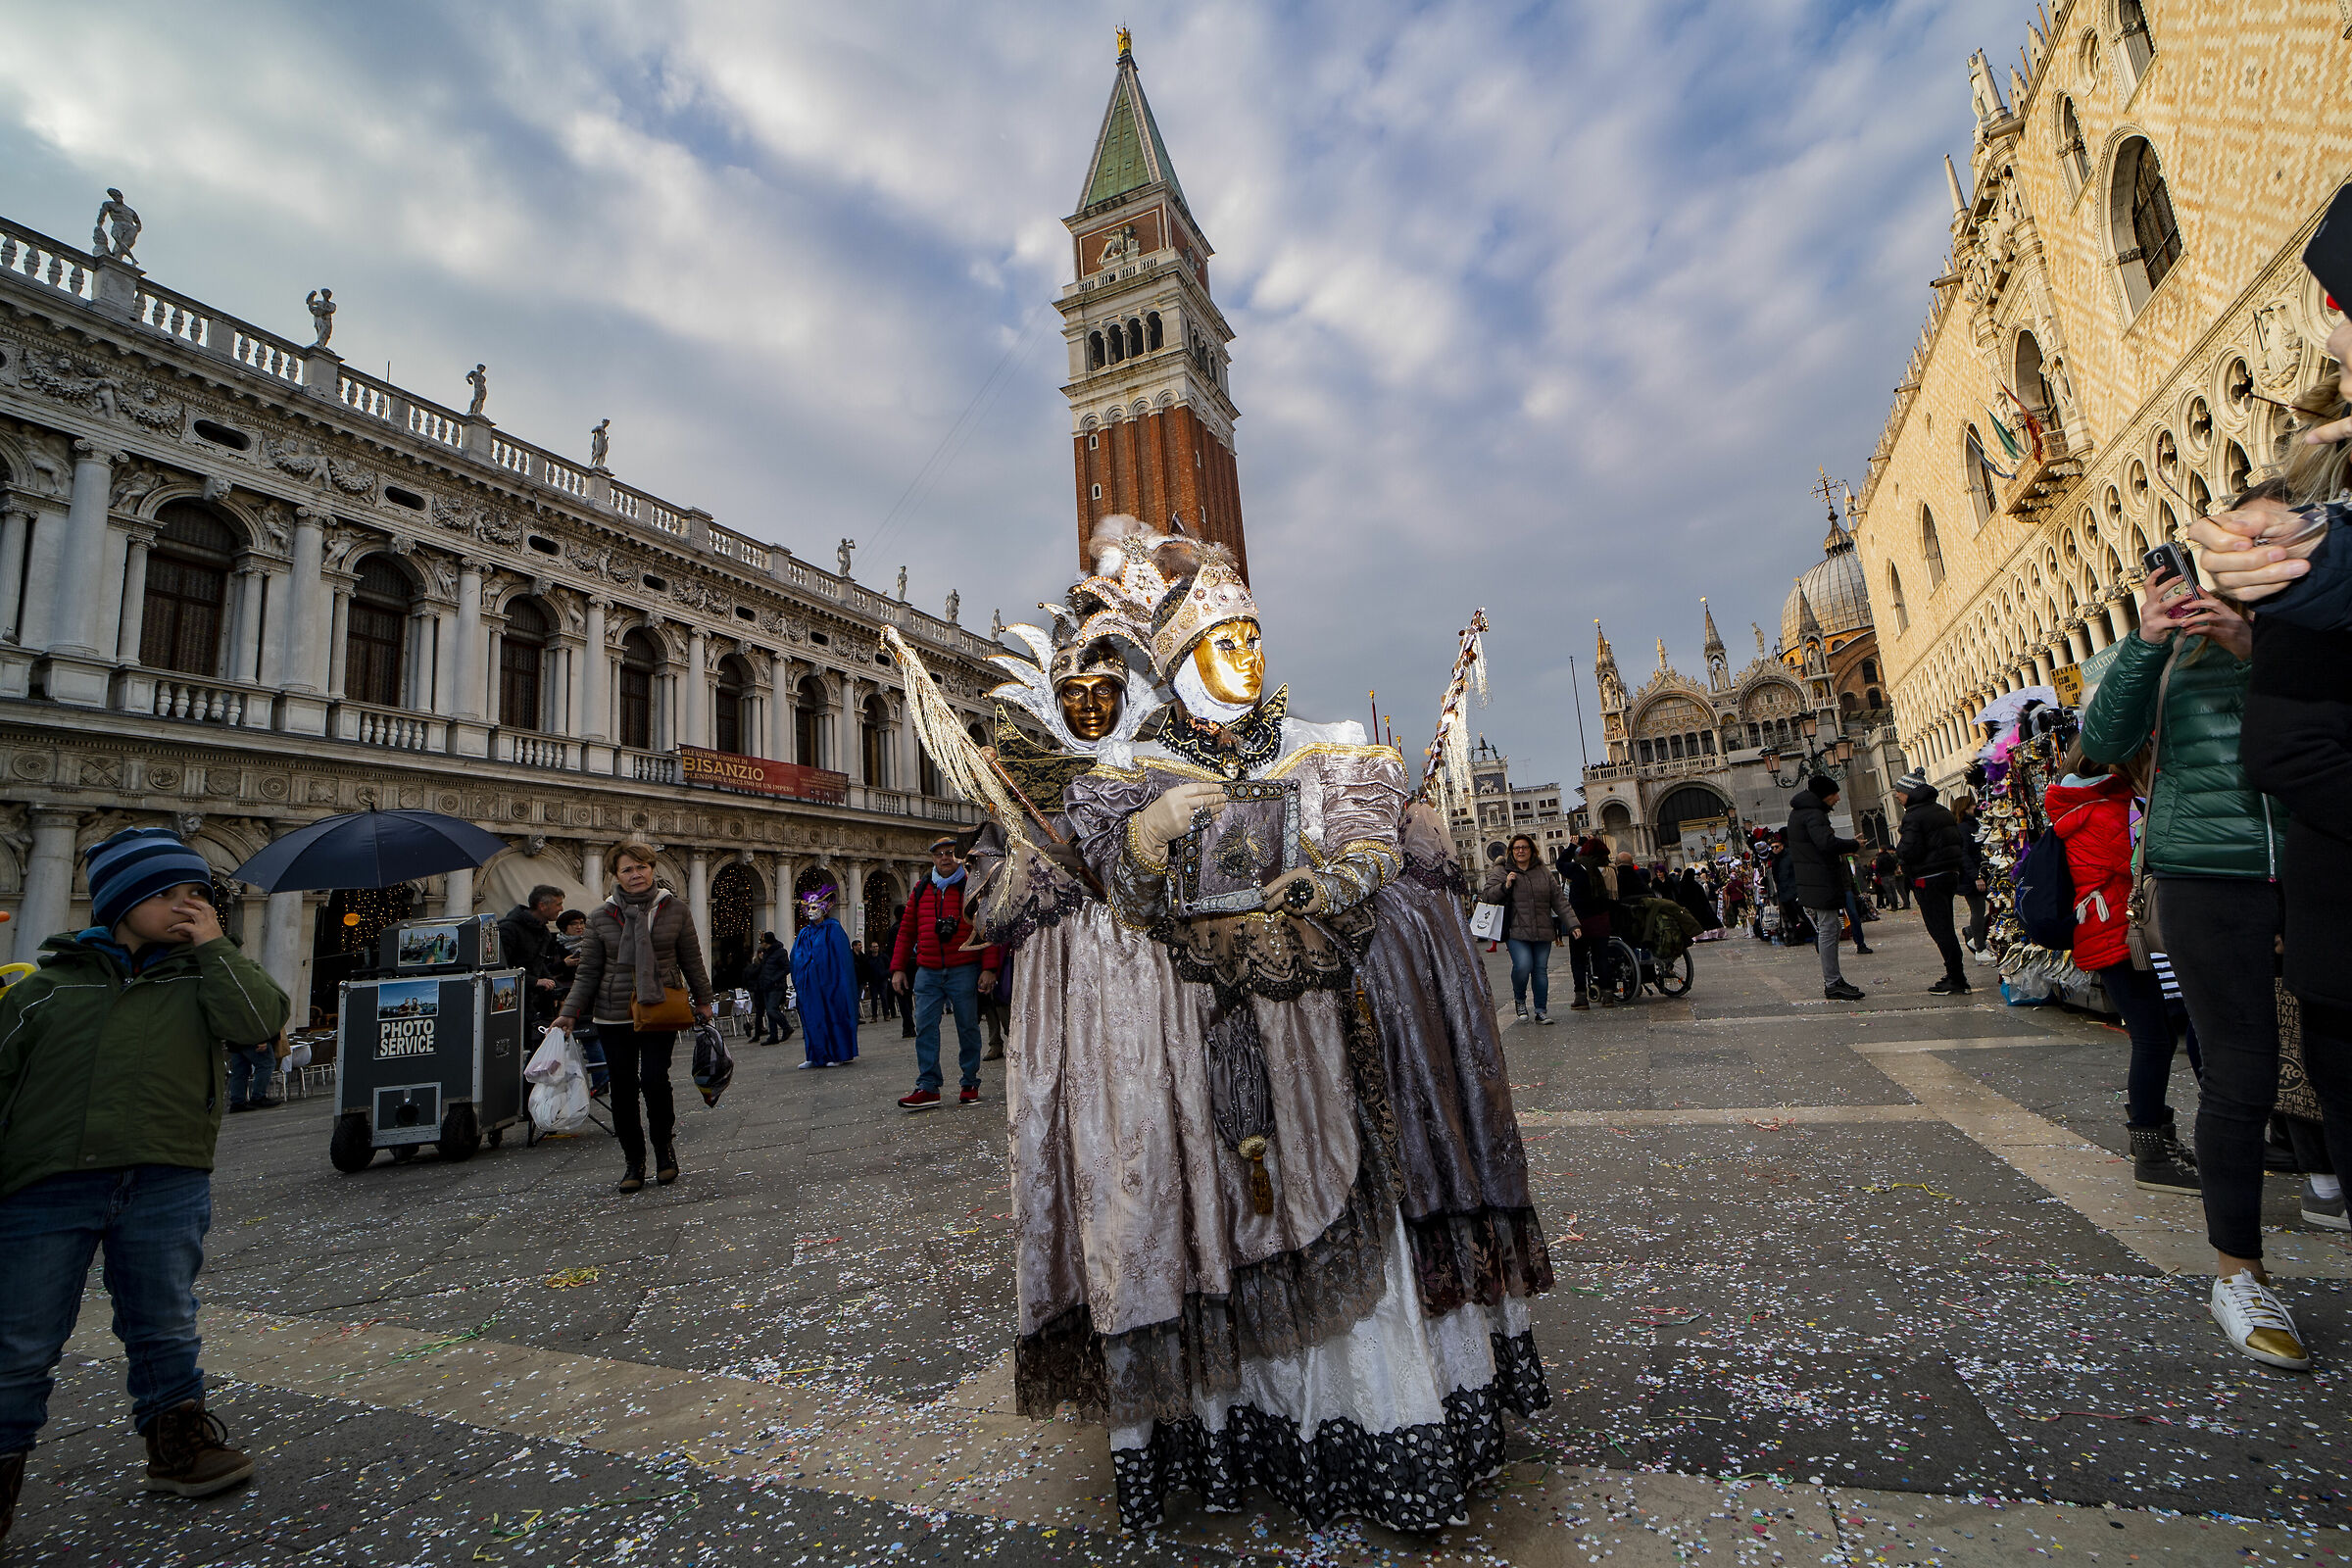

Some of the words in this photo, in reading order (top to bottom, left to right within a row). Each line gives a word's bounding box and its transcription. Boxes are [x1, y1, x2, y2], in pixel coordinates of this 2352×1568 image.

[696, 751, 717, 760] ULTIMI
[718, 755, 740, 763] GIORNI
[682, 756, 764, 781] BISANZIO
[684, 772, 722, 782] PLENDORE
[728, 778, 755, 787] DECLINO
[380, 1019, 434, 1039] PHOTO
[379, 1034, 434, 1056] SERVICE
[2286, 1093, 2317, 1107] PARIS
